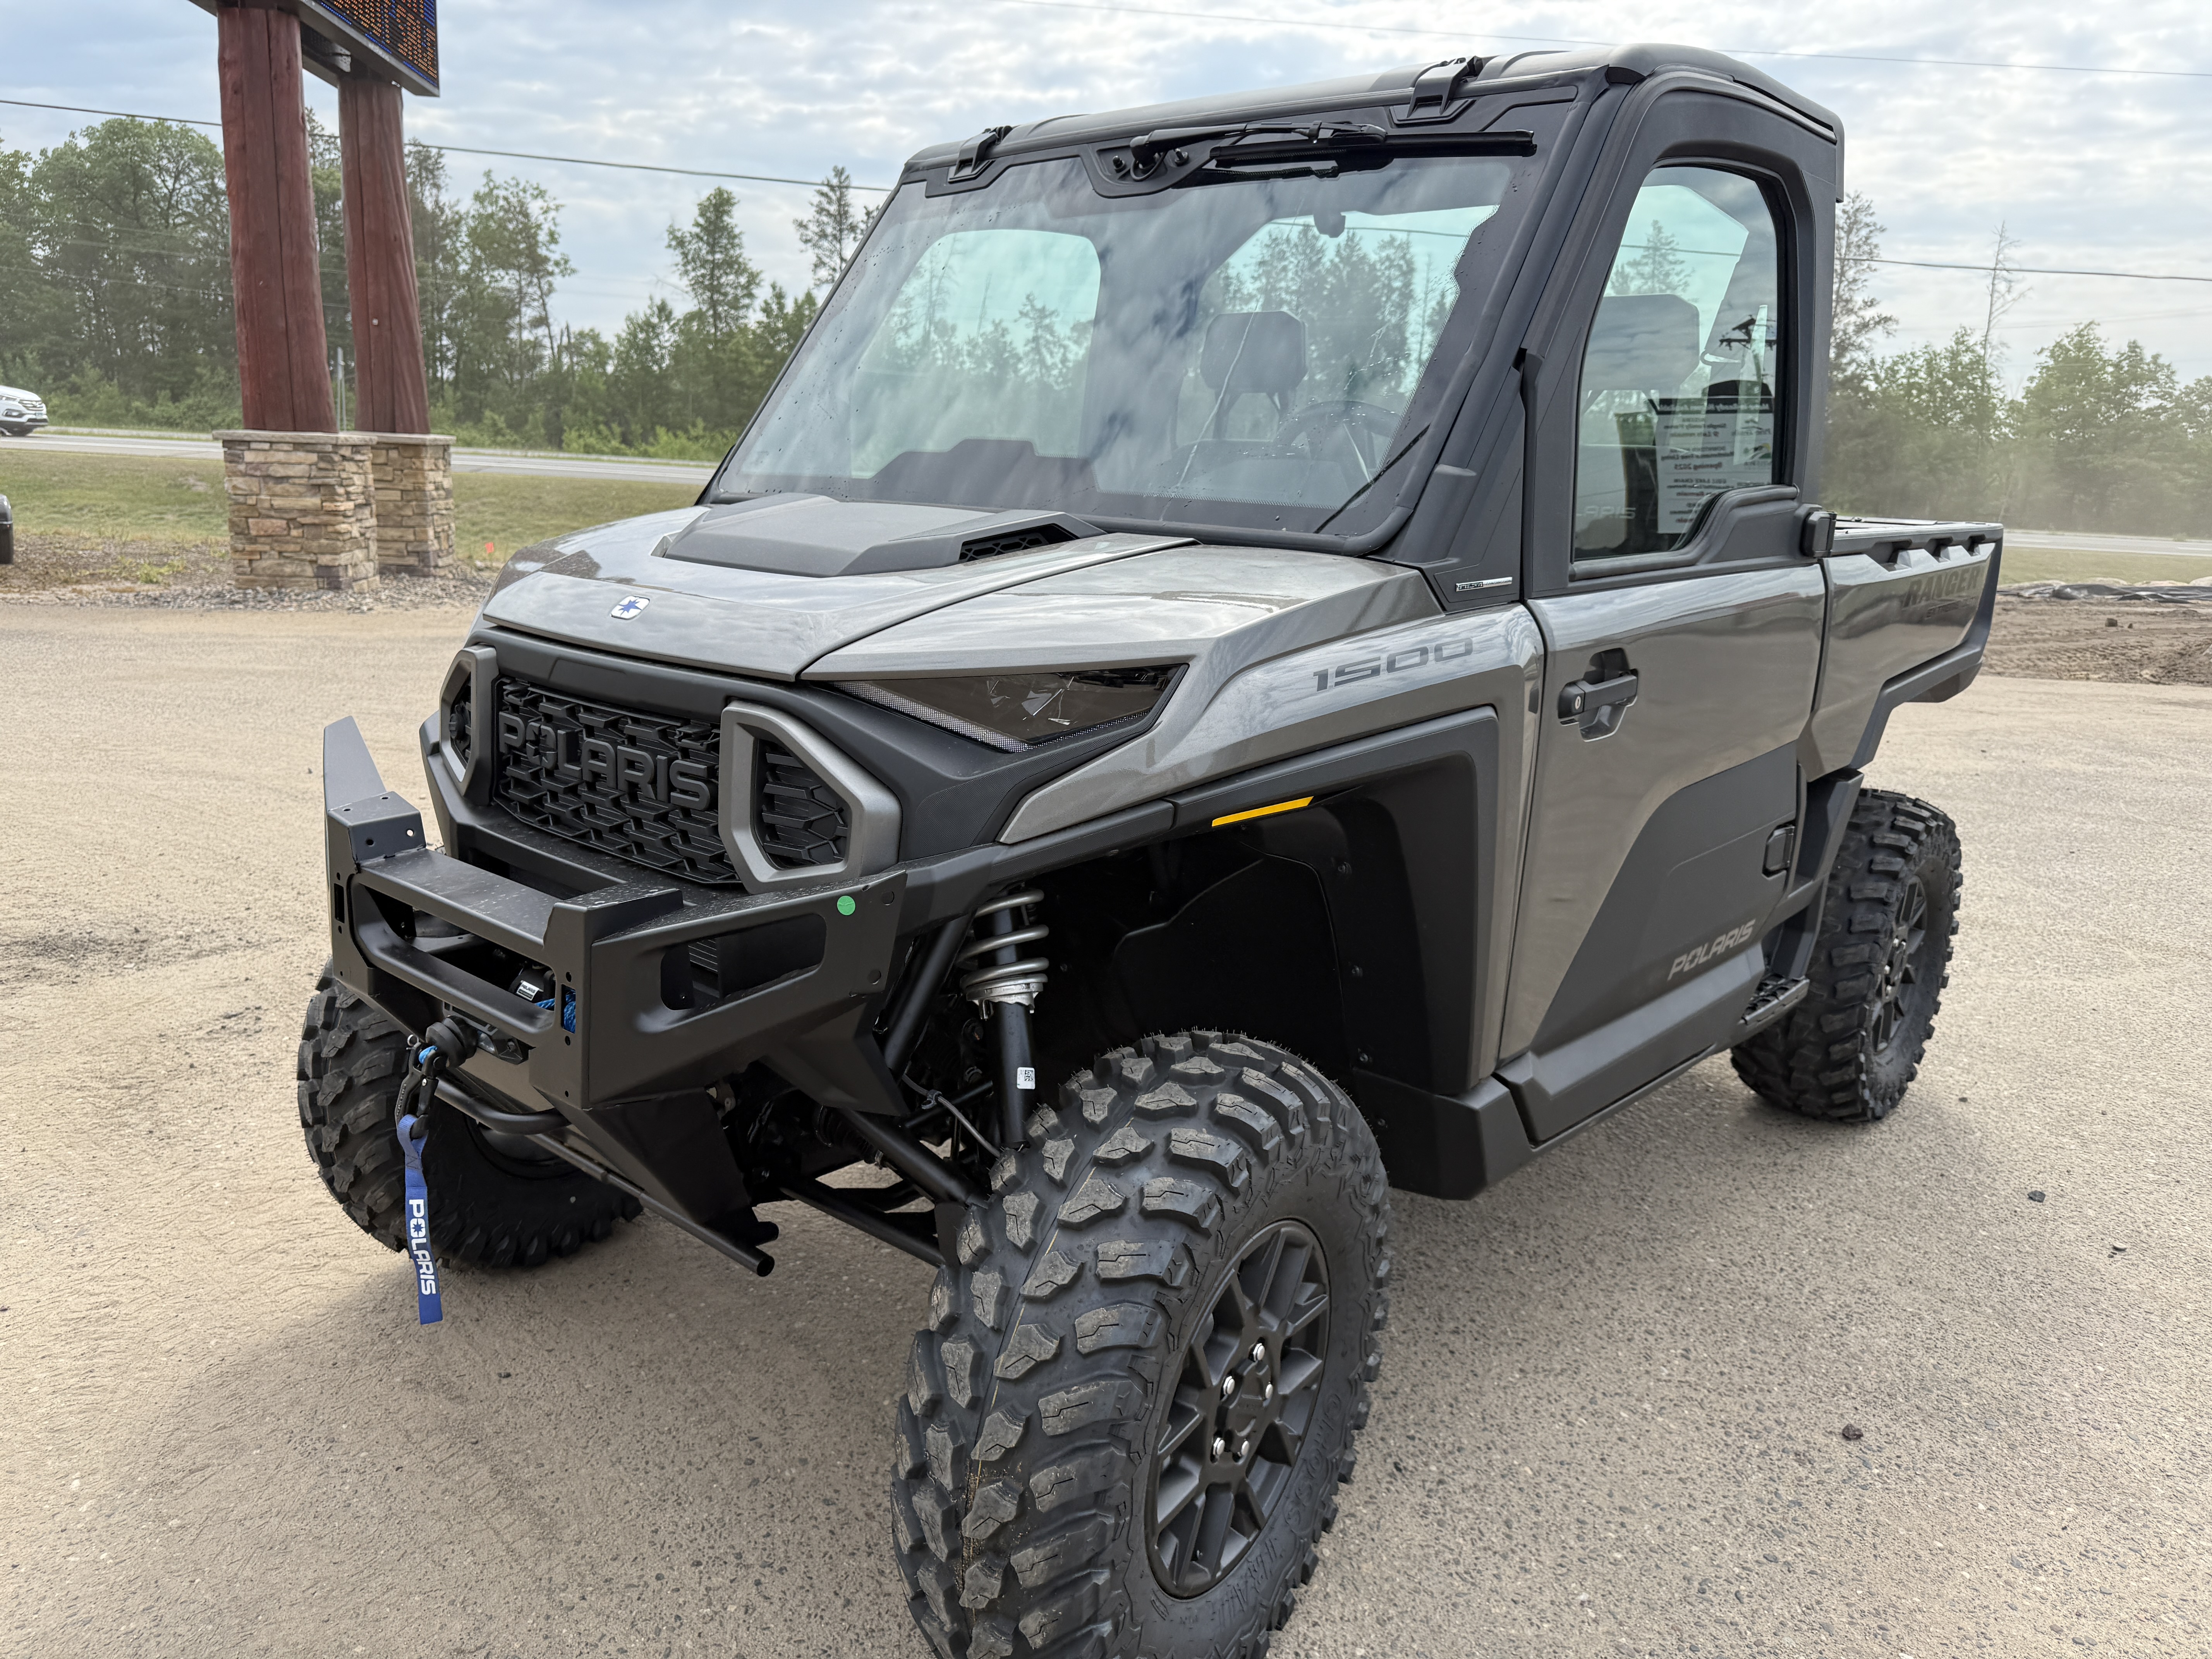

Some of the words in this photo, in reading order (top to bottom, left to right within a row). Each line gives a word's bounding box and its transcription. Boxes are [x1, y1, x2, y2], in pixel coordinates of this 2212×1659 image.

[1903, 565, 1981, 607] RANGER
[1313, 637, 1472, 692] 1500
[499, 710, 713, 811] POLARIS
[1667, 919, 1756, 981] POLARIS
[409, 1199, 436, 1296] POLARIS
